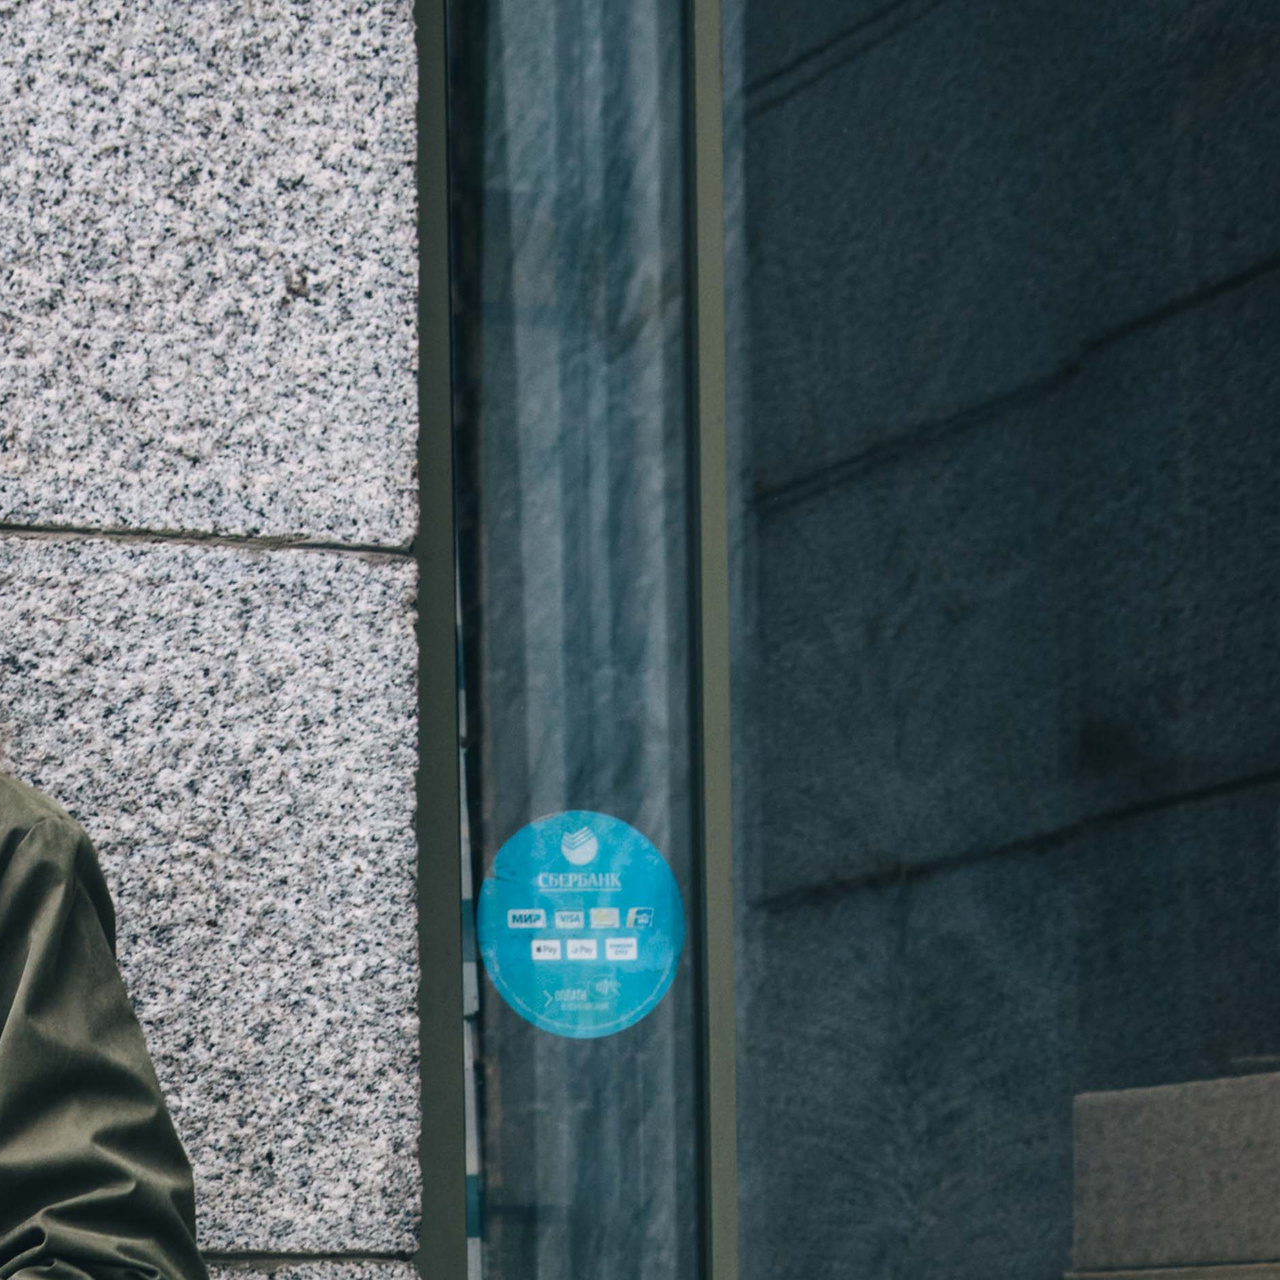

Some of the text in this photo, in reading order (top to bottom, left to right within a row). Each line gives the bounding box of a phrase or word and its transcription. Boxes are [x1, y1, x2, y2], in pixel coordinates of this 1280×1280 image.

[537, 872, 622, 887] СБЕРБАНК
[511, 914, 541, 923] МИР
[560, 914, 581, 923] VISA
